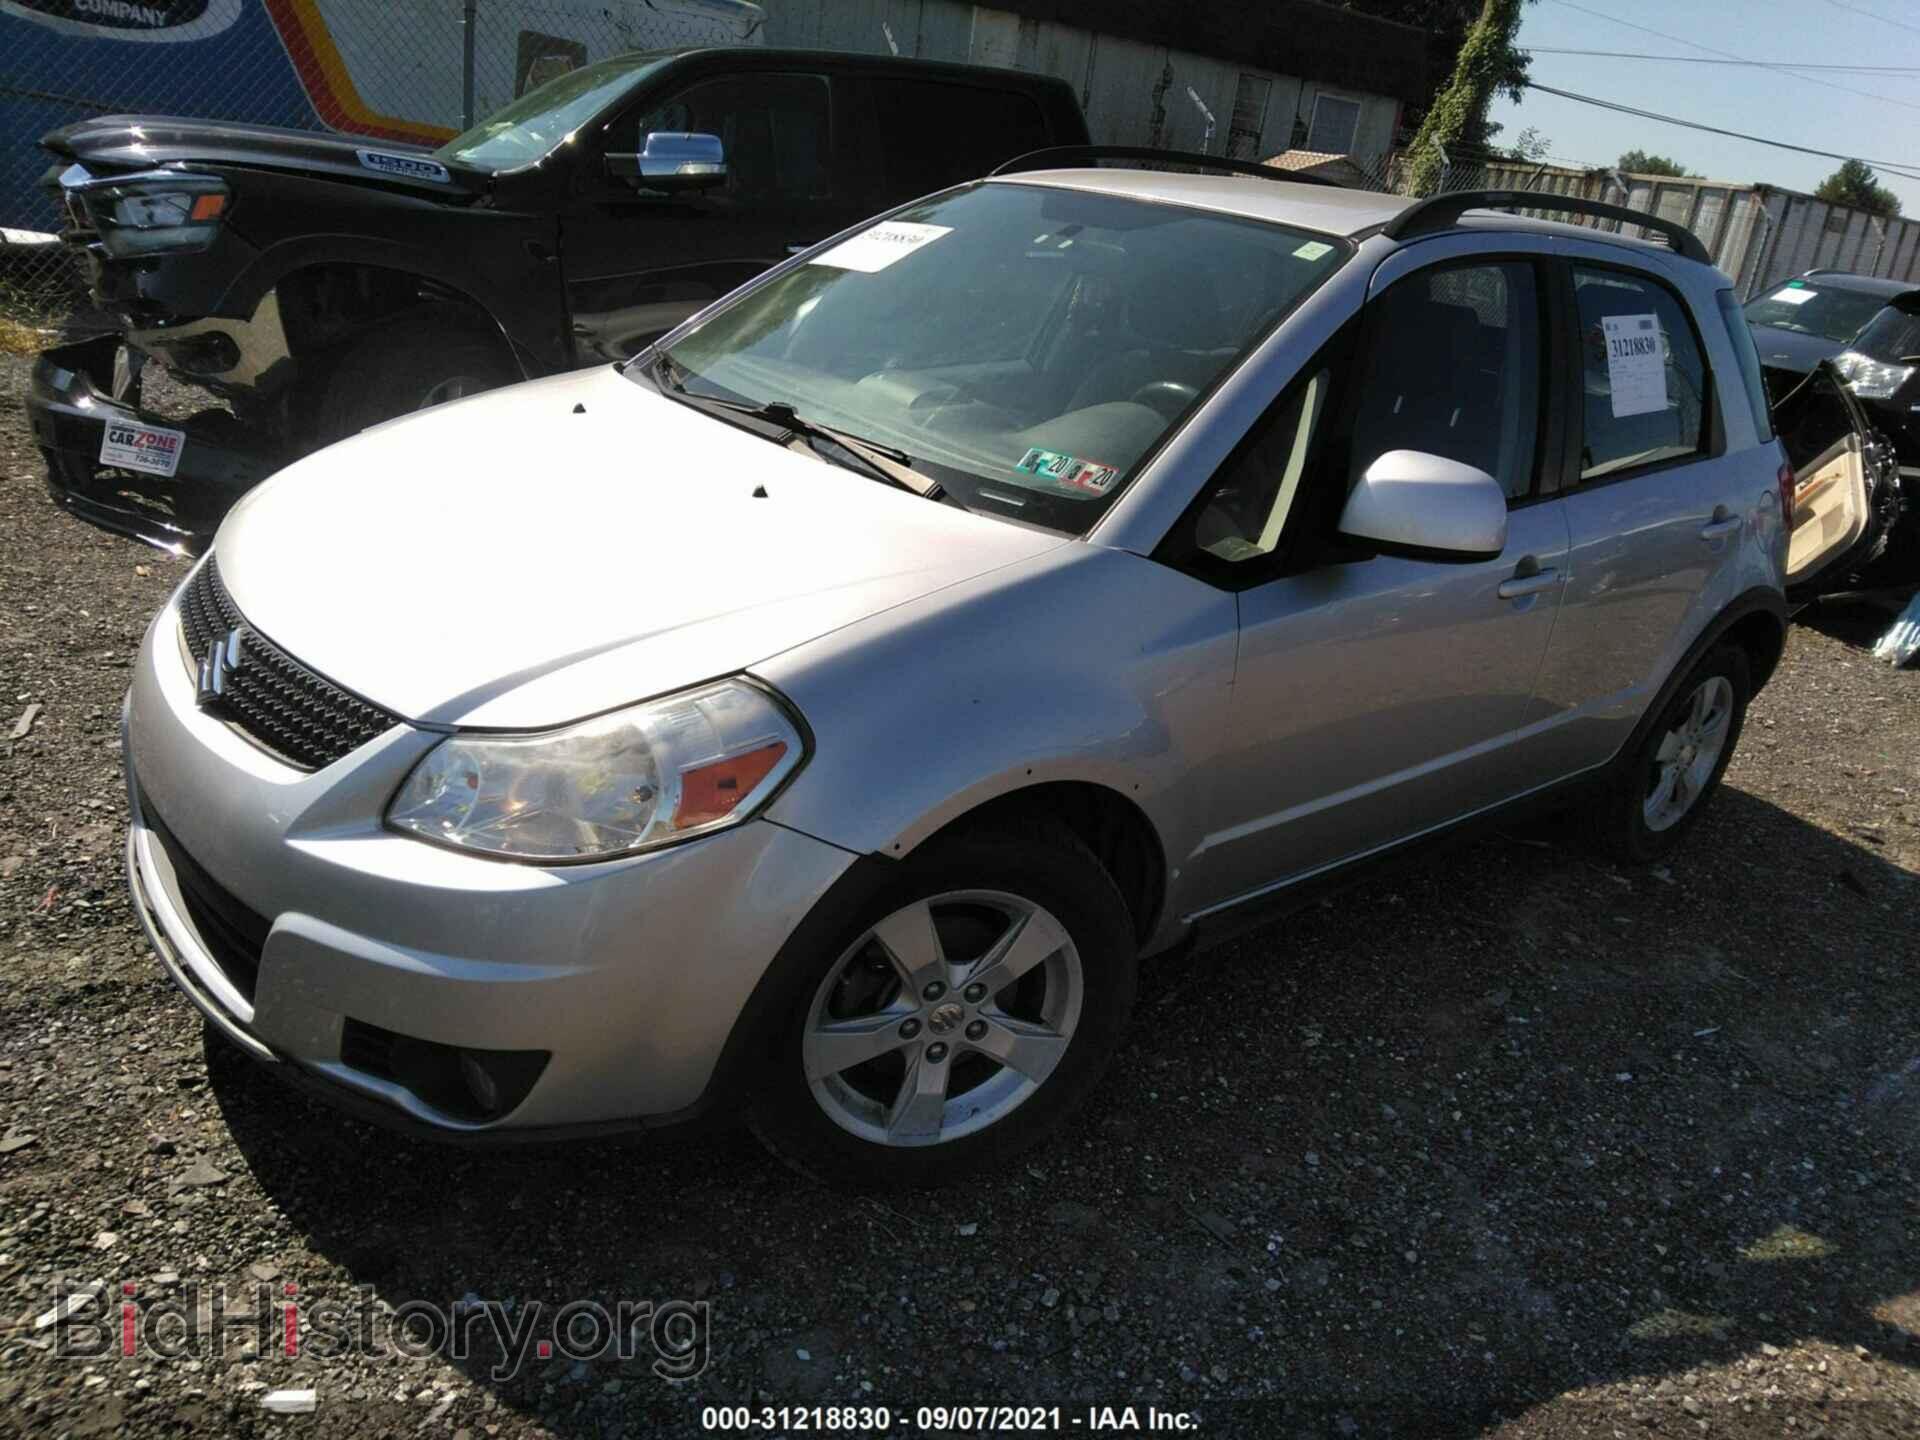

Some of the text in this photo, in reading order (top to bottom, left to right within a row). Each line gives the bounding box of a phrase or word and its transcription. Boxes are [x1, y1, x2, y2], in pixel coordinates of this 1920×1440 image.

[75, 0, 167, 26] COMPANY
[1611, 336, 1656, 357] 31218830
[1048, 456, 1069, 474] 20
[1093, 468, 1114, 486] 20
